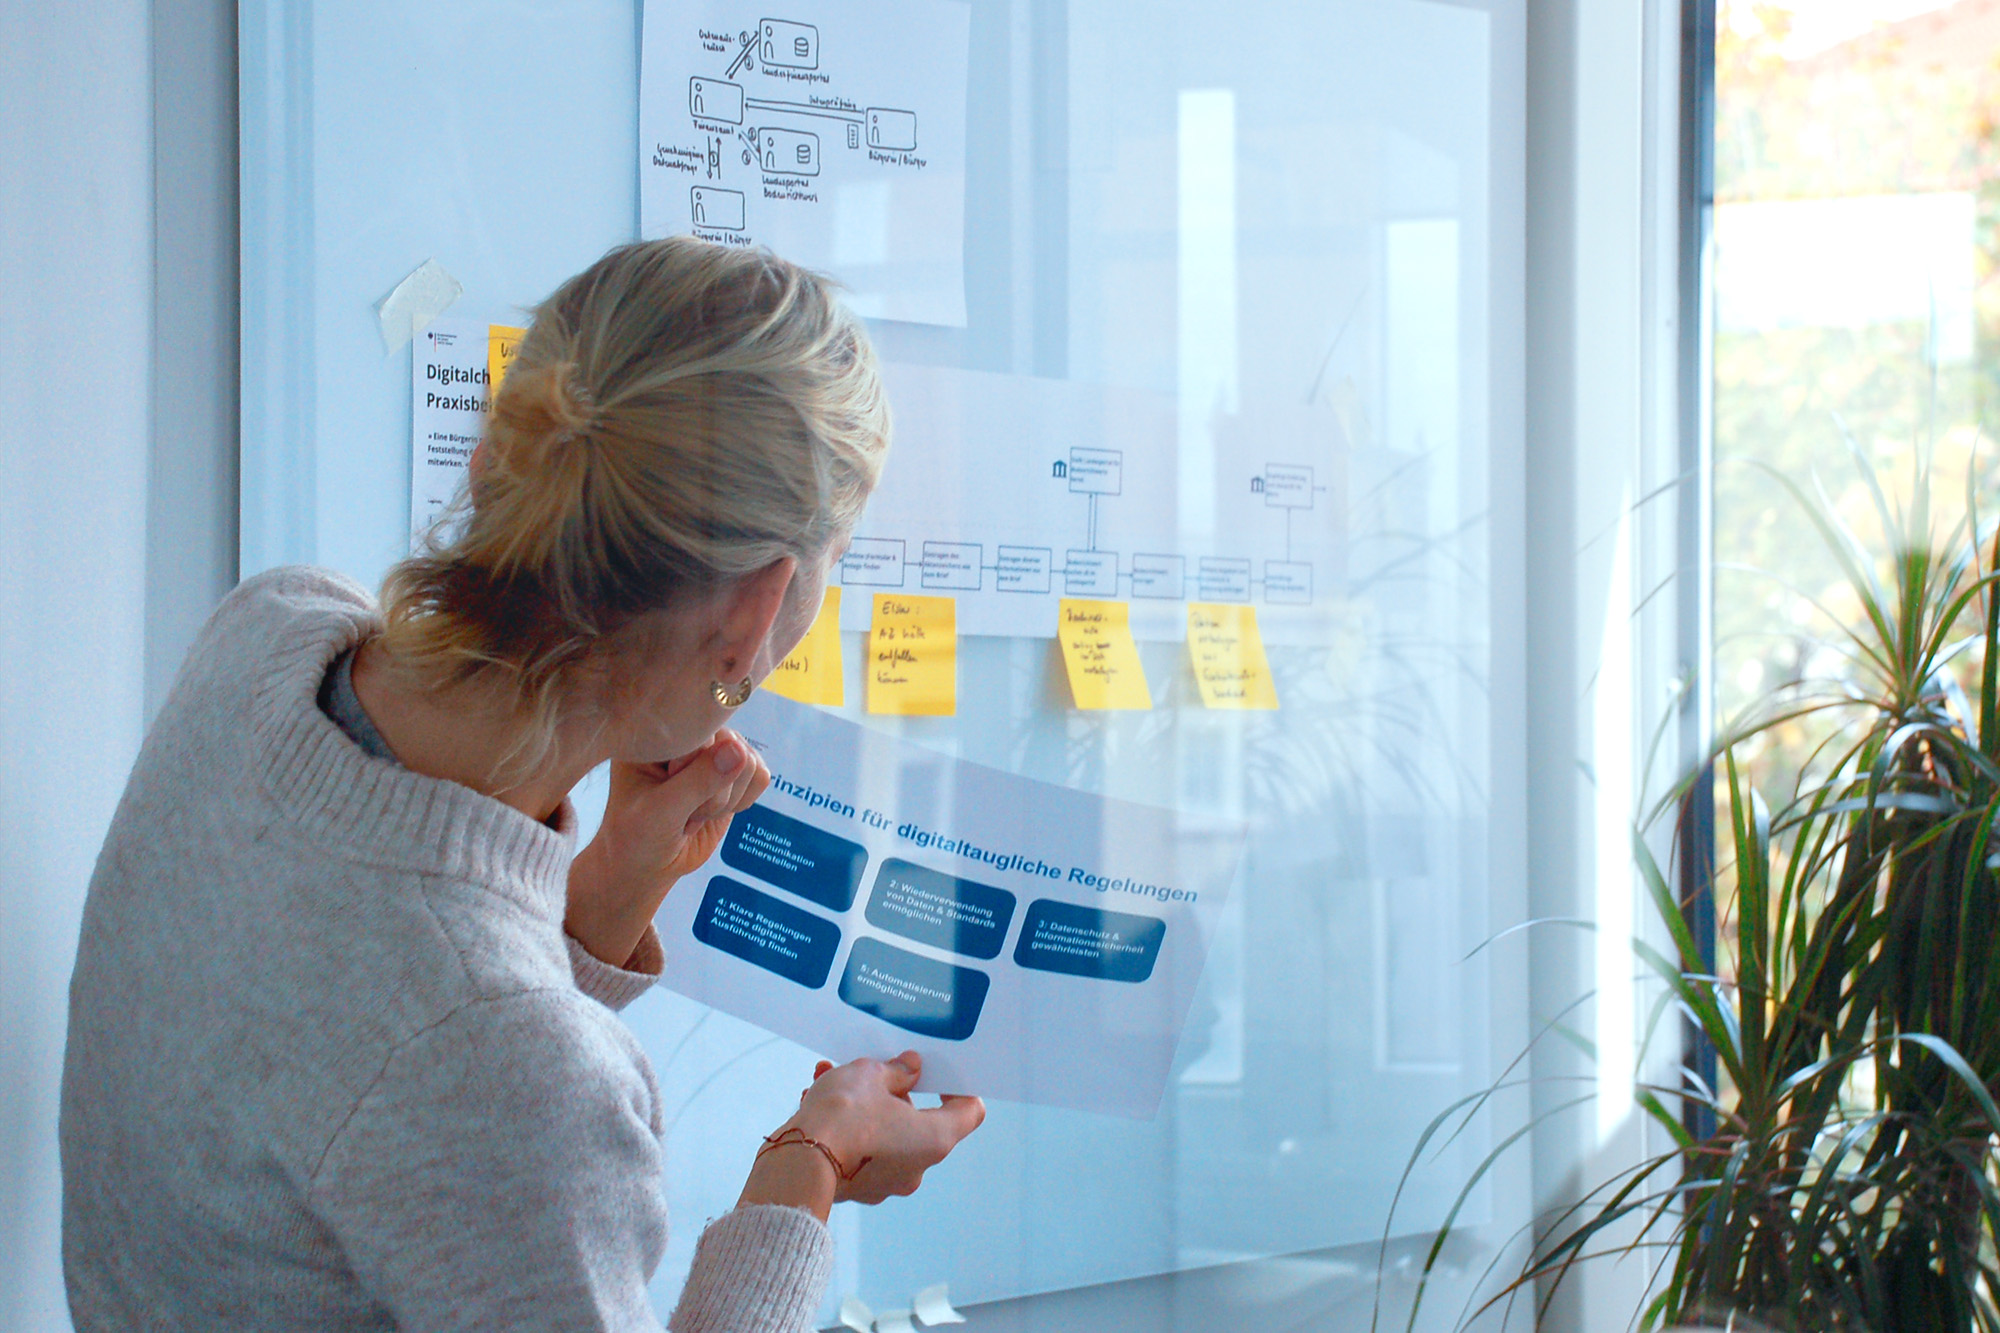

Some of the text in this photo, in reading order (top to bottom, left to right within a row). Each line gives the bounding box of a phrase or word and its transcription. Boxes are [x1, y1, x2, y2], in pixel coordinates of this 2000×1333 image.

[427, 363, 490, 385] Digitalch
[427, 392, 492, 413] Praxisbei
[428, 445, 468, 457] Feststellung
[434, 432, 447, 441] Eine
[746, 822, 792, 847] 1: Digitale
[738, 842, 798, 872] sicherstellen
[741, 832, 815, 868] Kommunikation
[861, 809, 893, 831] für
[897, 822, 1061, 879] digitaltaugliche
[1067, 867, 1198, 902] Regelungen
[882, 900, 942, 926] ermöglichen
[886, 891, 995, 929] von Daten & Standards
[889, 879, 993, 918] 2: Wiederverwendung
[714, 906, 786, 943] für eine digitale
[717, 897, 812, 944] 4: Klare Regelungen
[1038, 919, 1120, 940] 3: Datenschutz &
[710, 917, 798, 960] Ausführung finden
[1031, 941, 1100, 959] gewährleisten
[1034, 930, 1145, 954] Informationssicherheit
[857, 974, 916, 1003] ermöglichen
[860, 964, 951, 1004] 5: Automatisierung
